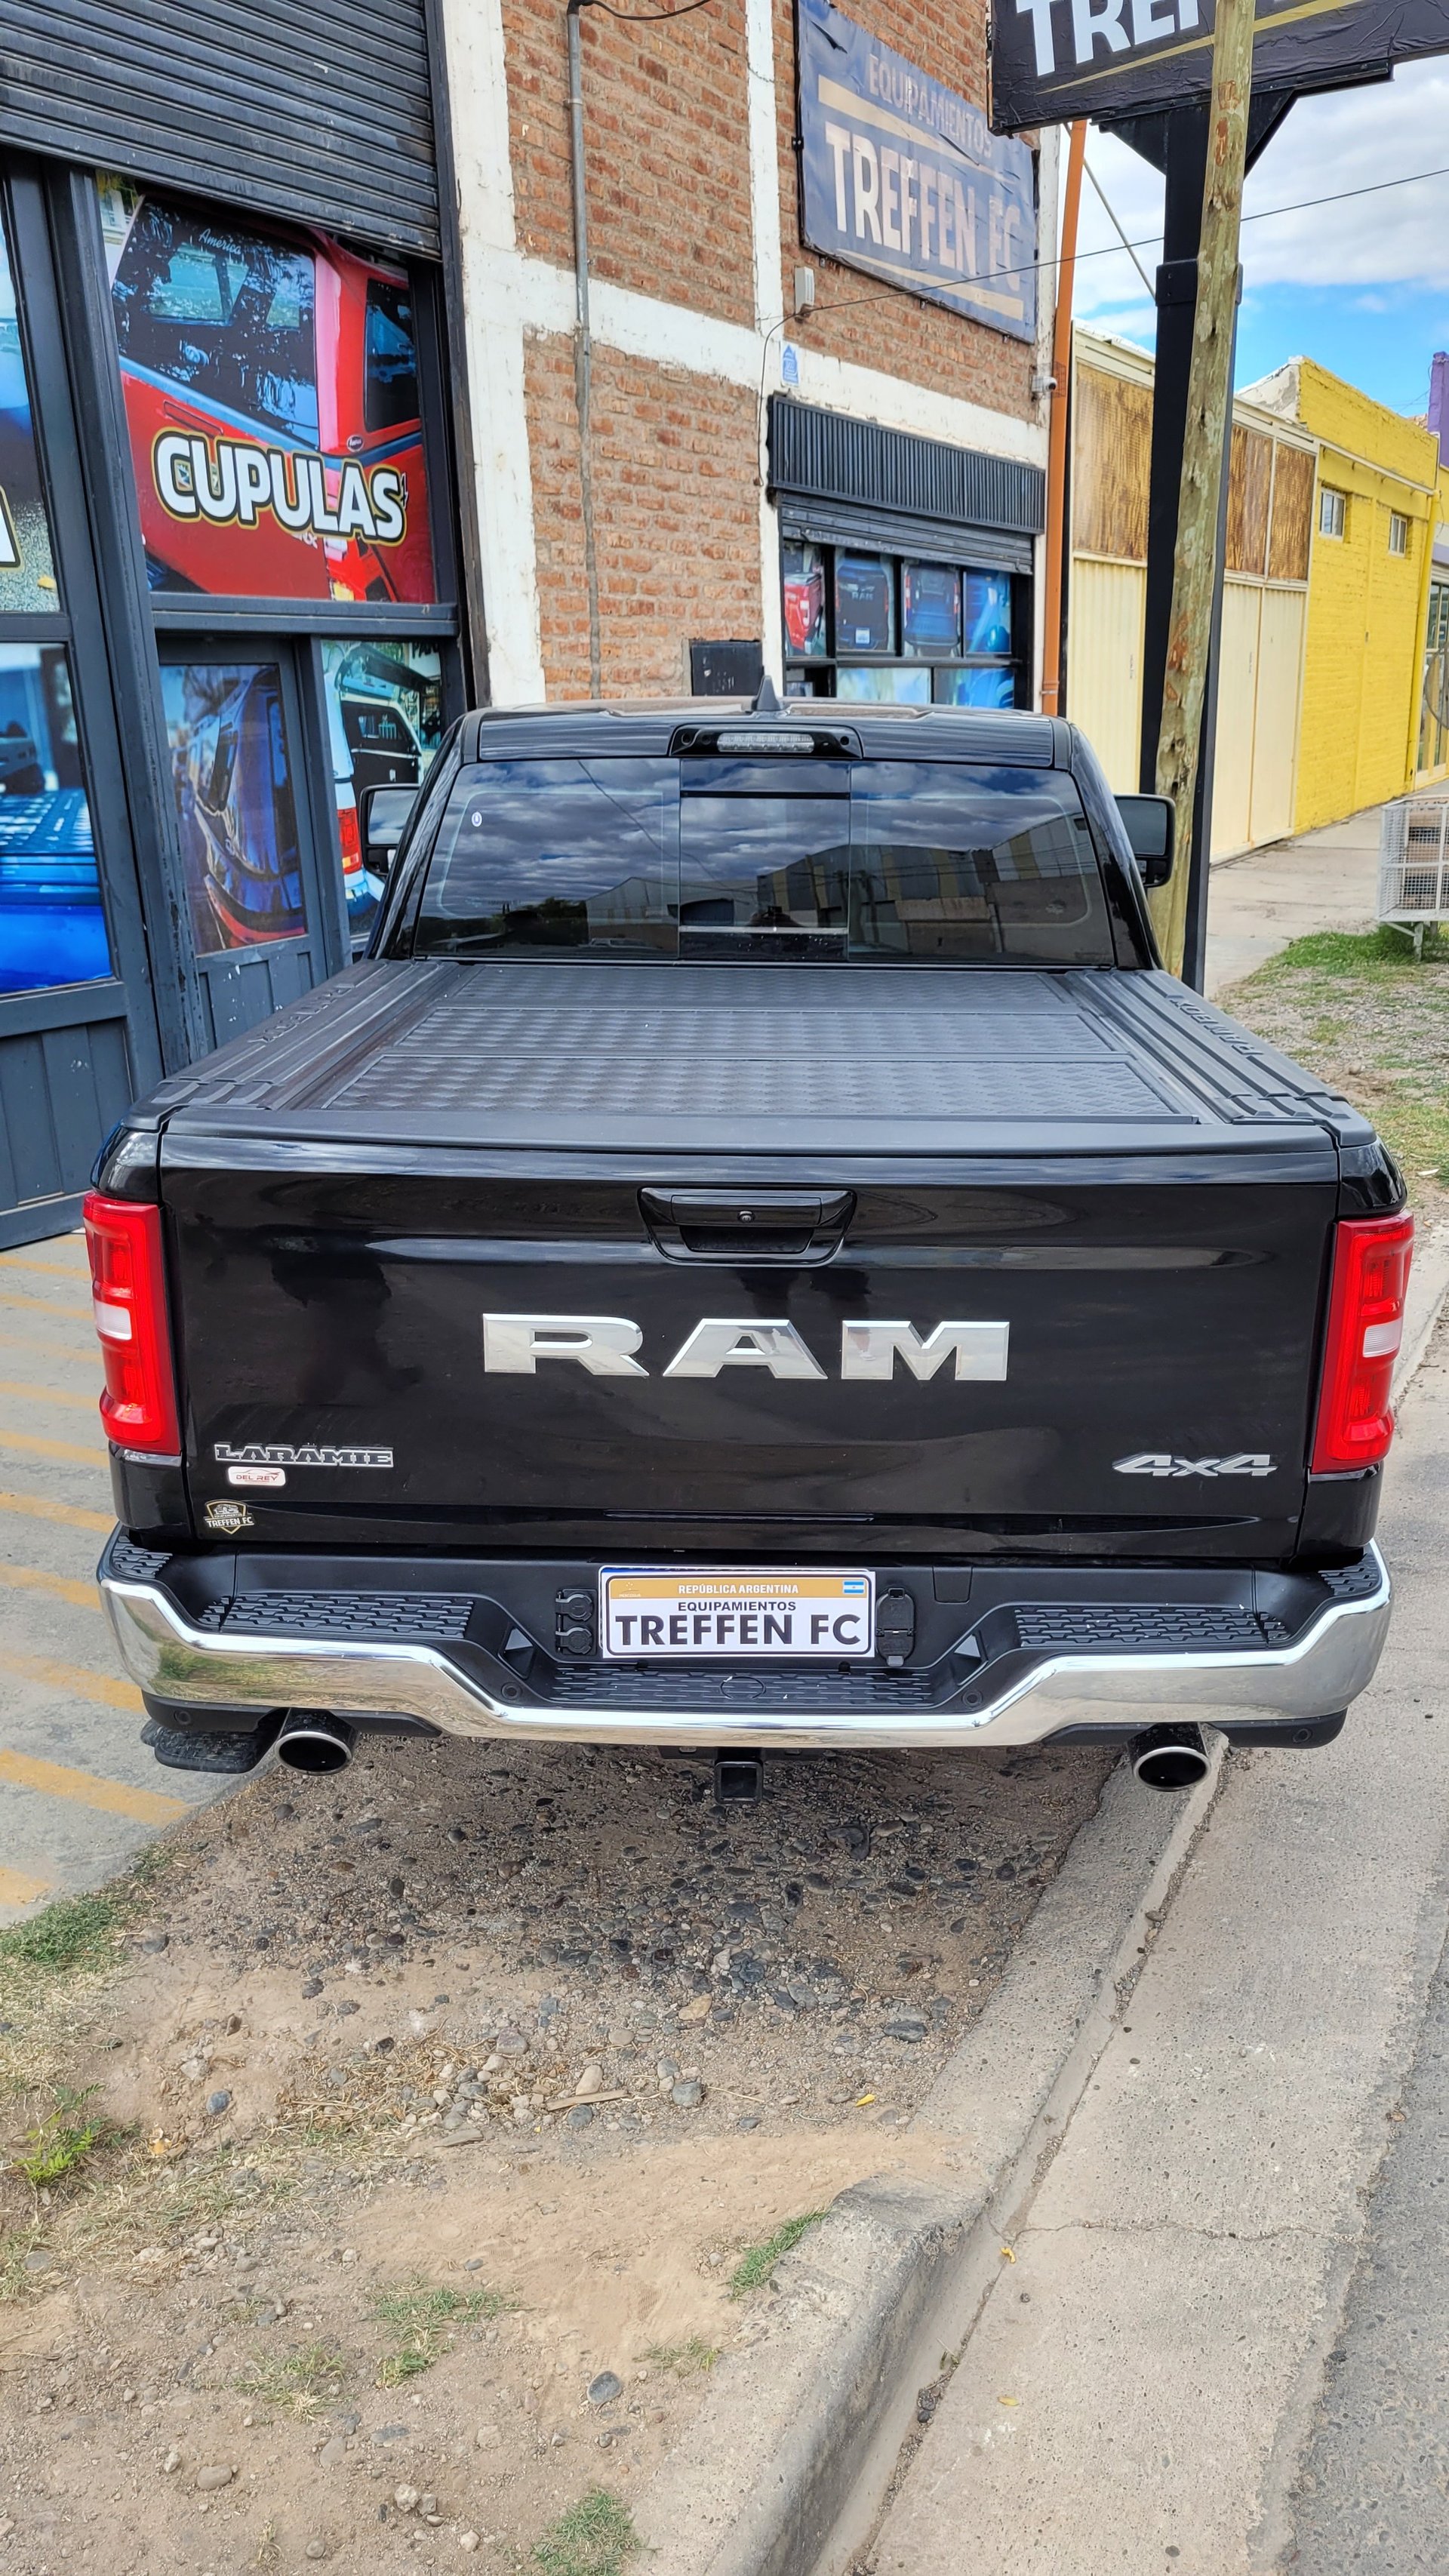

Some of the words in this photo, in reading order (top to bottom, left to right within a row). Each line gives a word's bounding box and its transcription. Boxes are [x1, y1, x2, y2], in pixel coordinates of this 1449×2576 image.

[1016, 0, 1199, 76] TRE
[869, 53, 992, 158] EQUIPAMIENTOS
[826, 122, 977, 276] TREFFEN
[989, 195, 1020, 292] FC
[198, 229, 242, 254] América
[155, 432, 405, 543] CUPULAS
[483, 1313, 1010, 1380] RAM
[214, 1443, 394, 1467] LARAMIE
[1112, 1453, 1278, 1476] 4x4
[207, 1517, 241, 1528] TREFFEN
[678, 1583, 737, 1594] REPÚBLICA
[738, 1583, 799, 1594] ARGENTINA
[678, 1601, 796, 1611] EQUIPAMIENTOS
[615, 1614, 792, 1645] TREFFEN
[811, 1614, 861, 1645] FC
